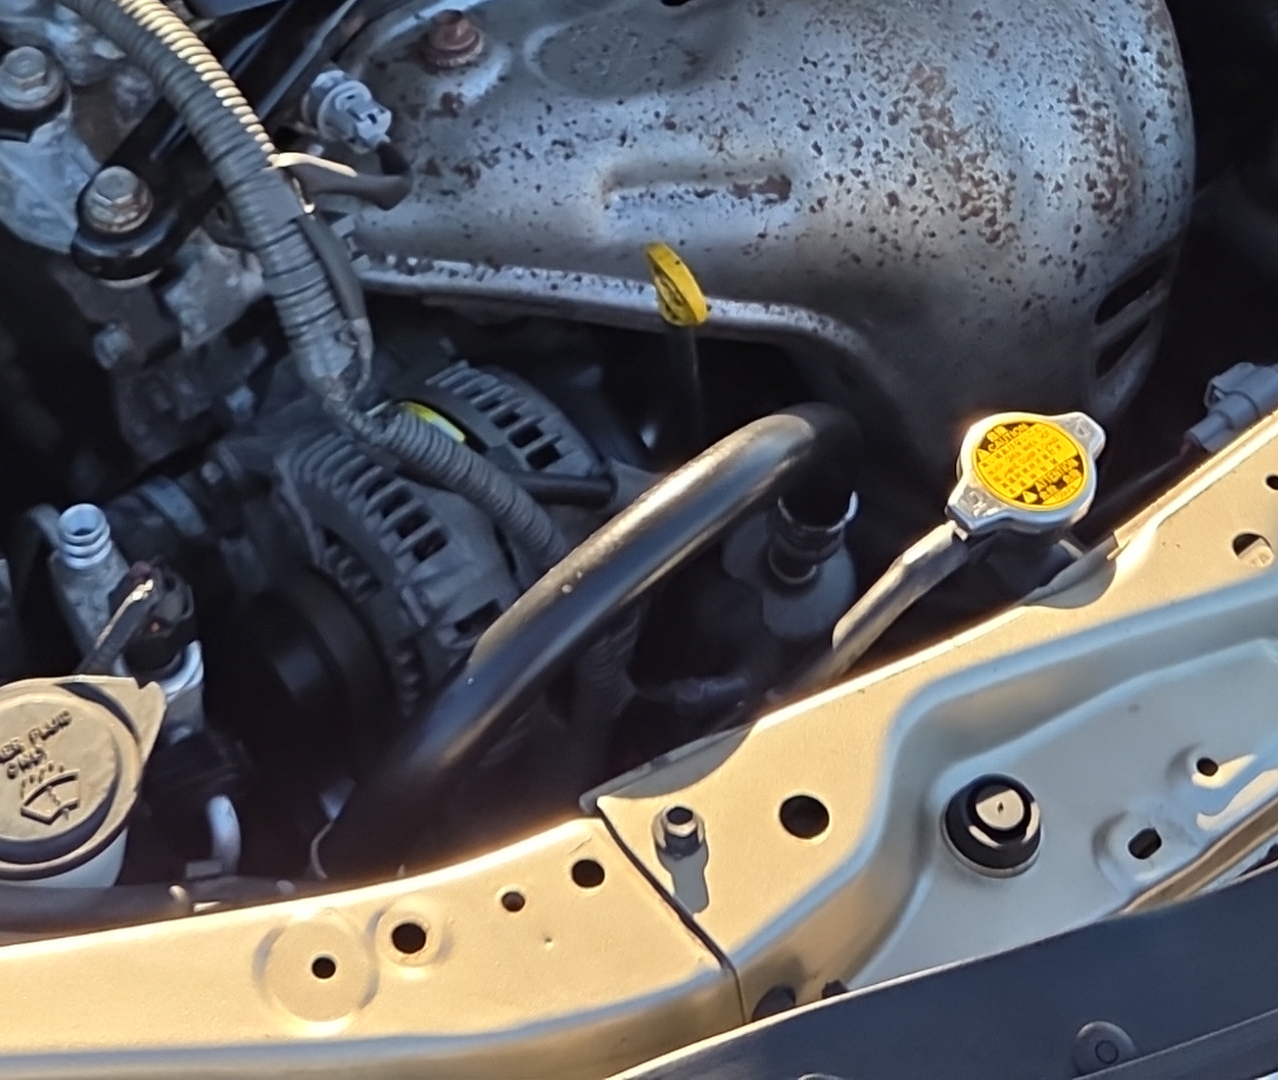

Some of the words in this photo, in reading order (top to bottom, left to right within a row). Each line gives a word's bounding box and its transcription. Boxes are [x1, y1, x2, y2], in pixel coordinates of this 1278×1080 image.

[987, 422, 1031, 452] CAUTION
[1035, 457, 1079, 492] ATTENTION
[27, 709, 72, 747] FLUID
[6, 744, 47, 780] ONLY
